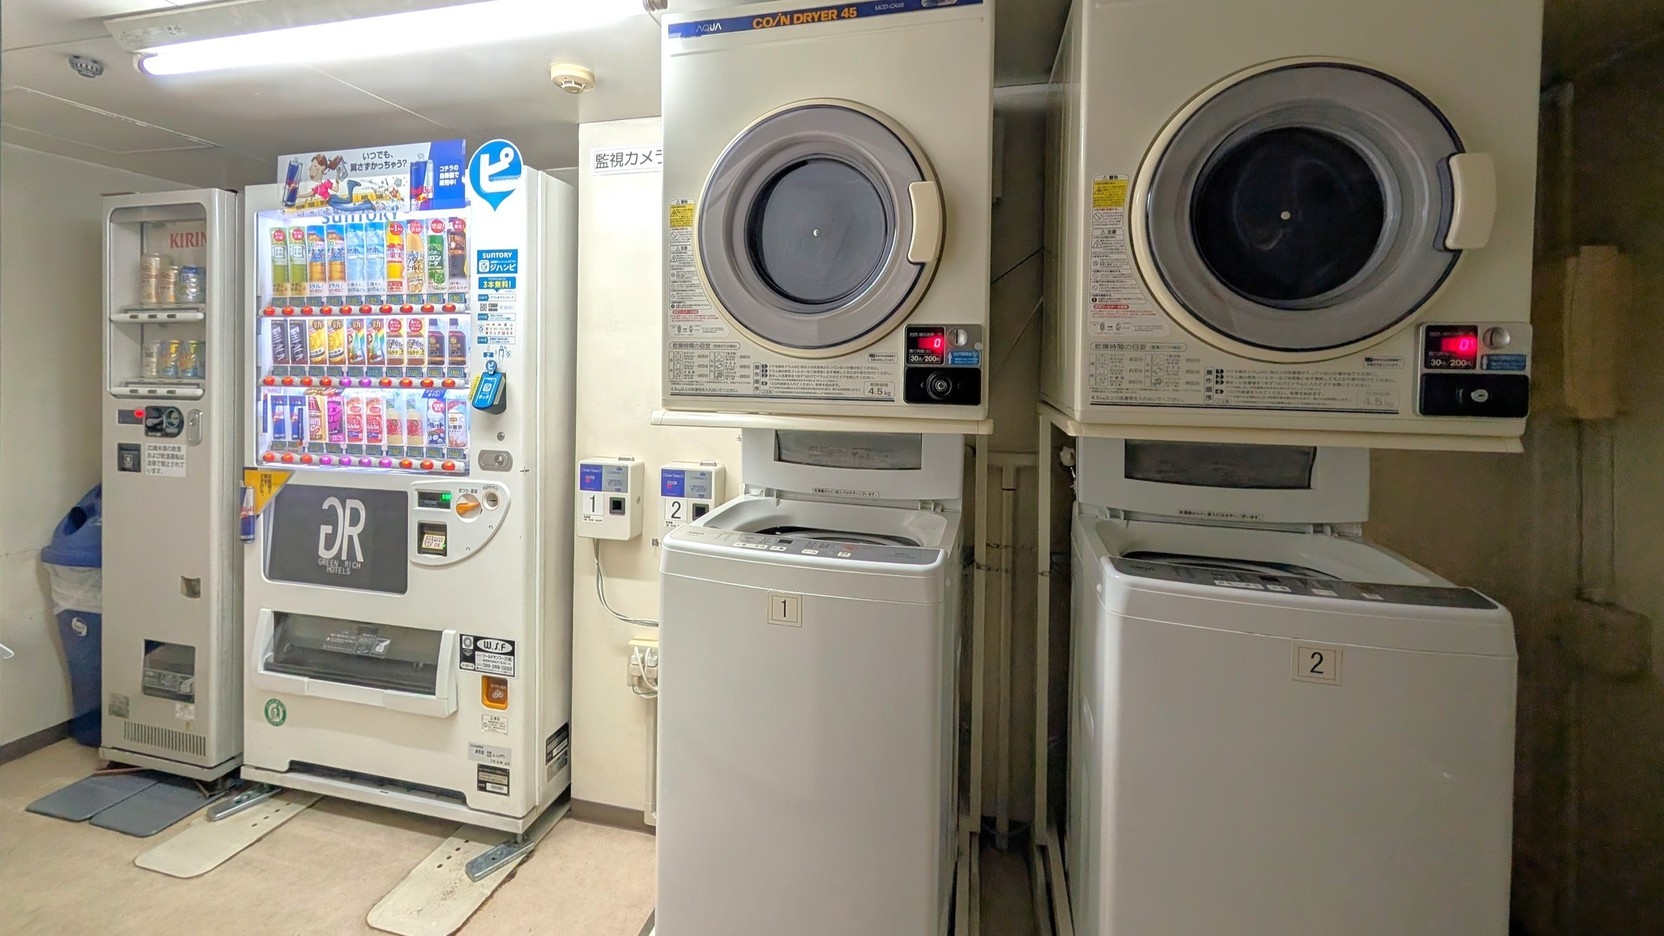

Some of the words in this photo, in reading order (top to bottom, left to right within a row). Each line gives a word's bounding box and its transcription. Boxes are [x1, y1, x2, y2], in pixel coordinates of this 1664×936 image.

[793, 8, 837, 24] DRYER
[841, 7, 858, 19] 45
[696, 22, 722, 33] AQUA
[362, 150, 394, 161] いつでも、
[439, 164, 459, 172] コチラの
[933, 338, 941, 348] 0
[1459, 339, 1469, 350] 0
[589, 495, 596, 513] 1
[671, 501, 681, 519] 2
[318, 558, 339, 567] GREEN
[345, 561, 361, 570] RICH
[327, 566, 351, 575] HOTELS
[780, 599, 787, 618] 1
[483, 640, 506, 651] W.S.F
[1309, 651, 1324, 674] 2
